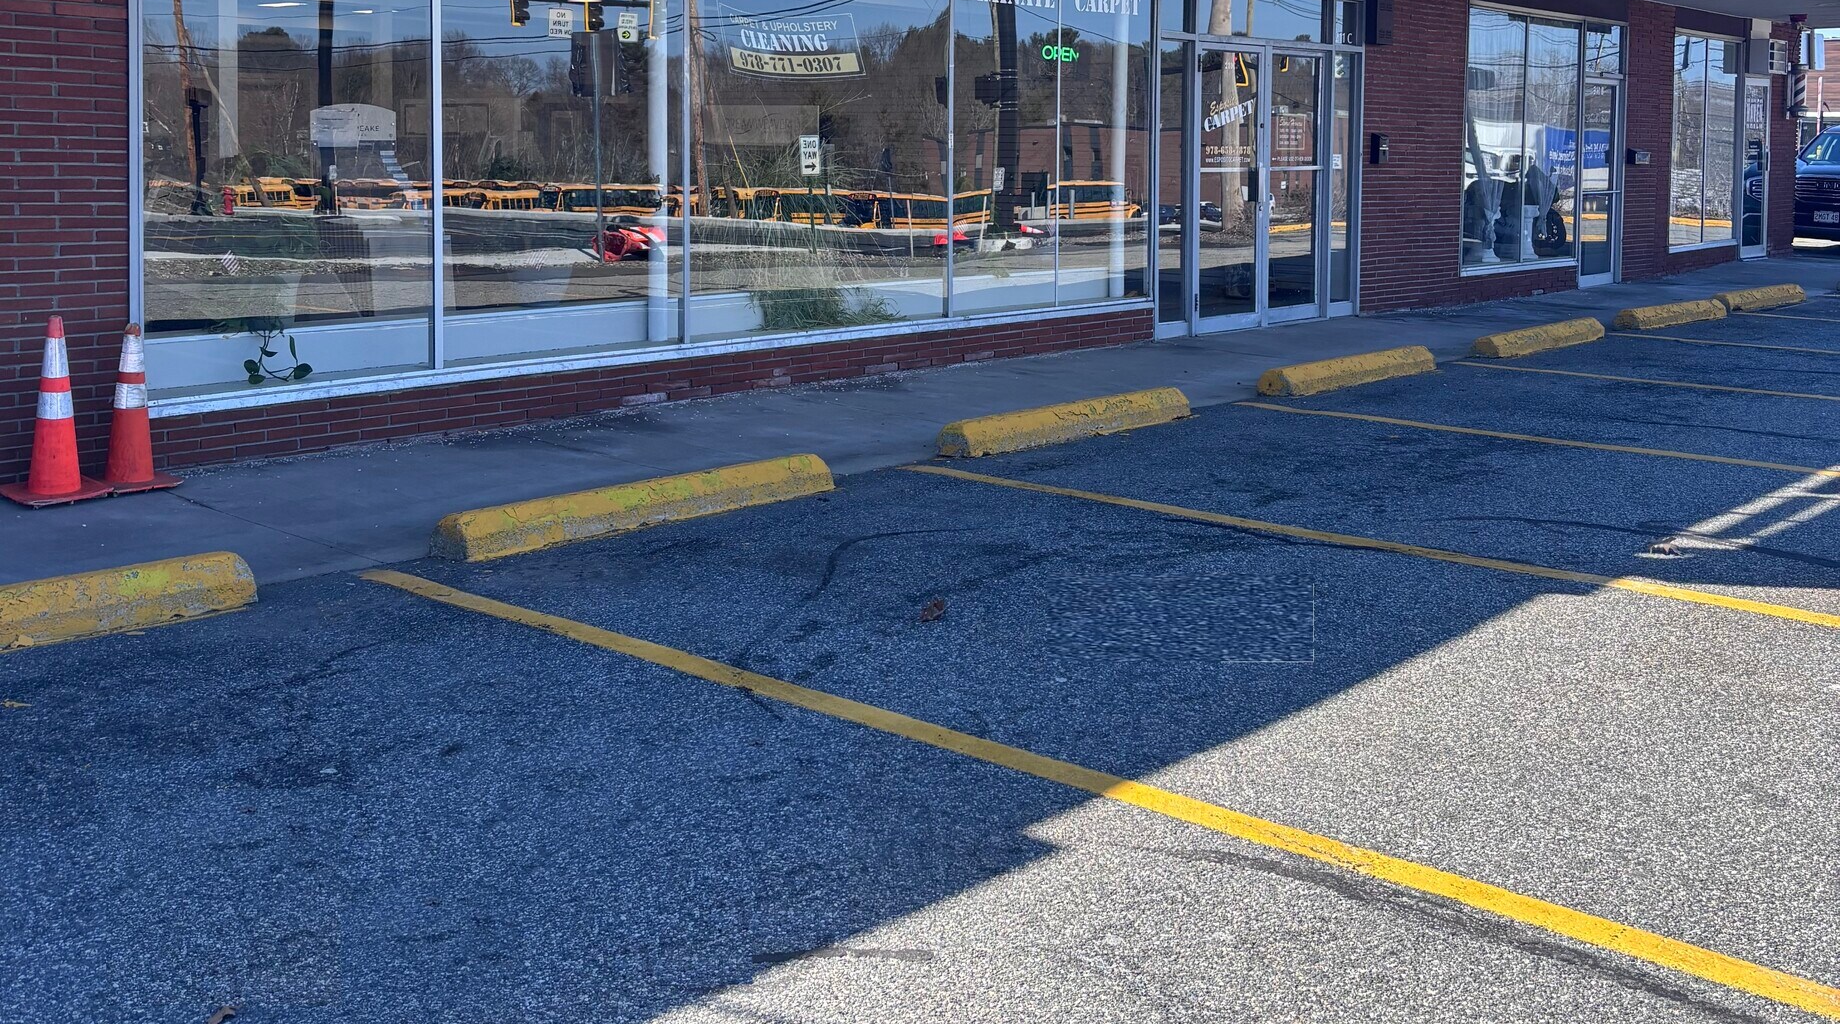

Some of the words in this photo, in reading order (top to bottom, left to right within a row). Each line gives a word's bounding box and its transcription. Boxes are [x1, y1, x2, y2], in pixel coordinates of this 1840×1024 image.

[769, 20, 838, 32] UPHOLSTERY
[740, 29, 829, 52] CLEANING
[739, 51, 841, 73] 978-771-0307
[1042, 45, 1079, 62] OPEN
[1203, 97, 1256, 132] CARPET
